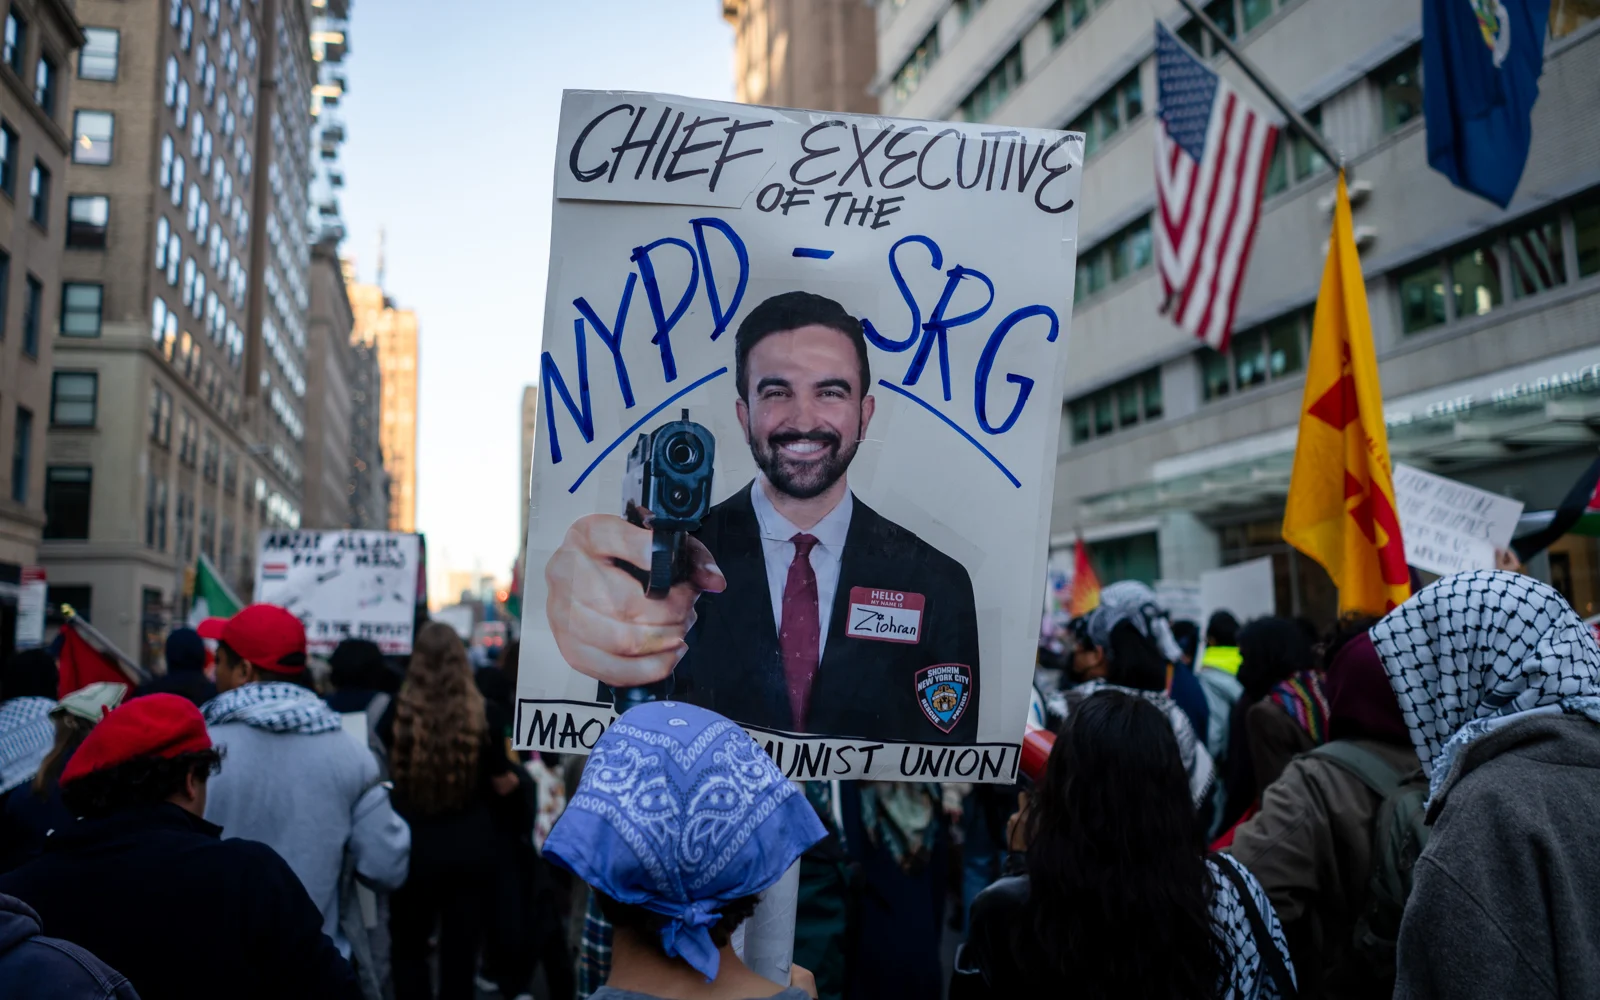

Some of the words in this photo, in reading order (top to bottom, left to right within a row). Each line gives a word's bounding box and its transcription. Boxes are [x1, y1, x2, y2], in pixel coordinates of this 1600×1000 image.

[569, 104, 774, 193] CHIEF
[789, 120, 1085, 214] EXECUTIVE
[756, 183, 815, 213] OF
[824, 194, 905, 230] THE
[540, 216, 749, 464] NYPD
[862, 235, 1060, 435] SRG
[871, 590, 904, 602] HELLO
[917, 677, 934, 692] NEW
[934, 673, 953, 683] YORK
[954, 674, 969, 685] CITY
[927, 666, 960, 678] SHOMRIM
[921, 698, 940, 724] RESCUE
[952, 691, 969, 720] PATROL
[527, 709, 615, 750] MAO
[900, 745, 1006, 781] UNION
